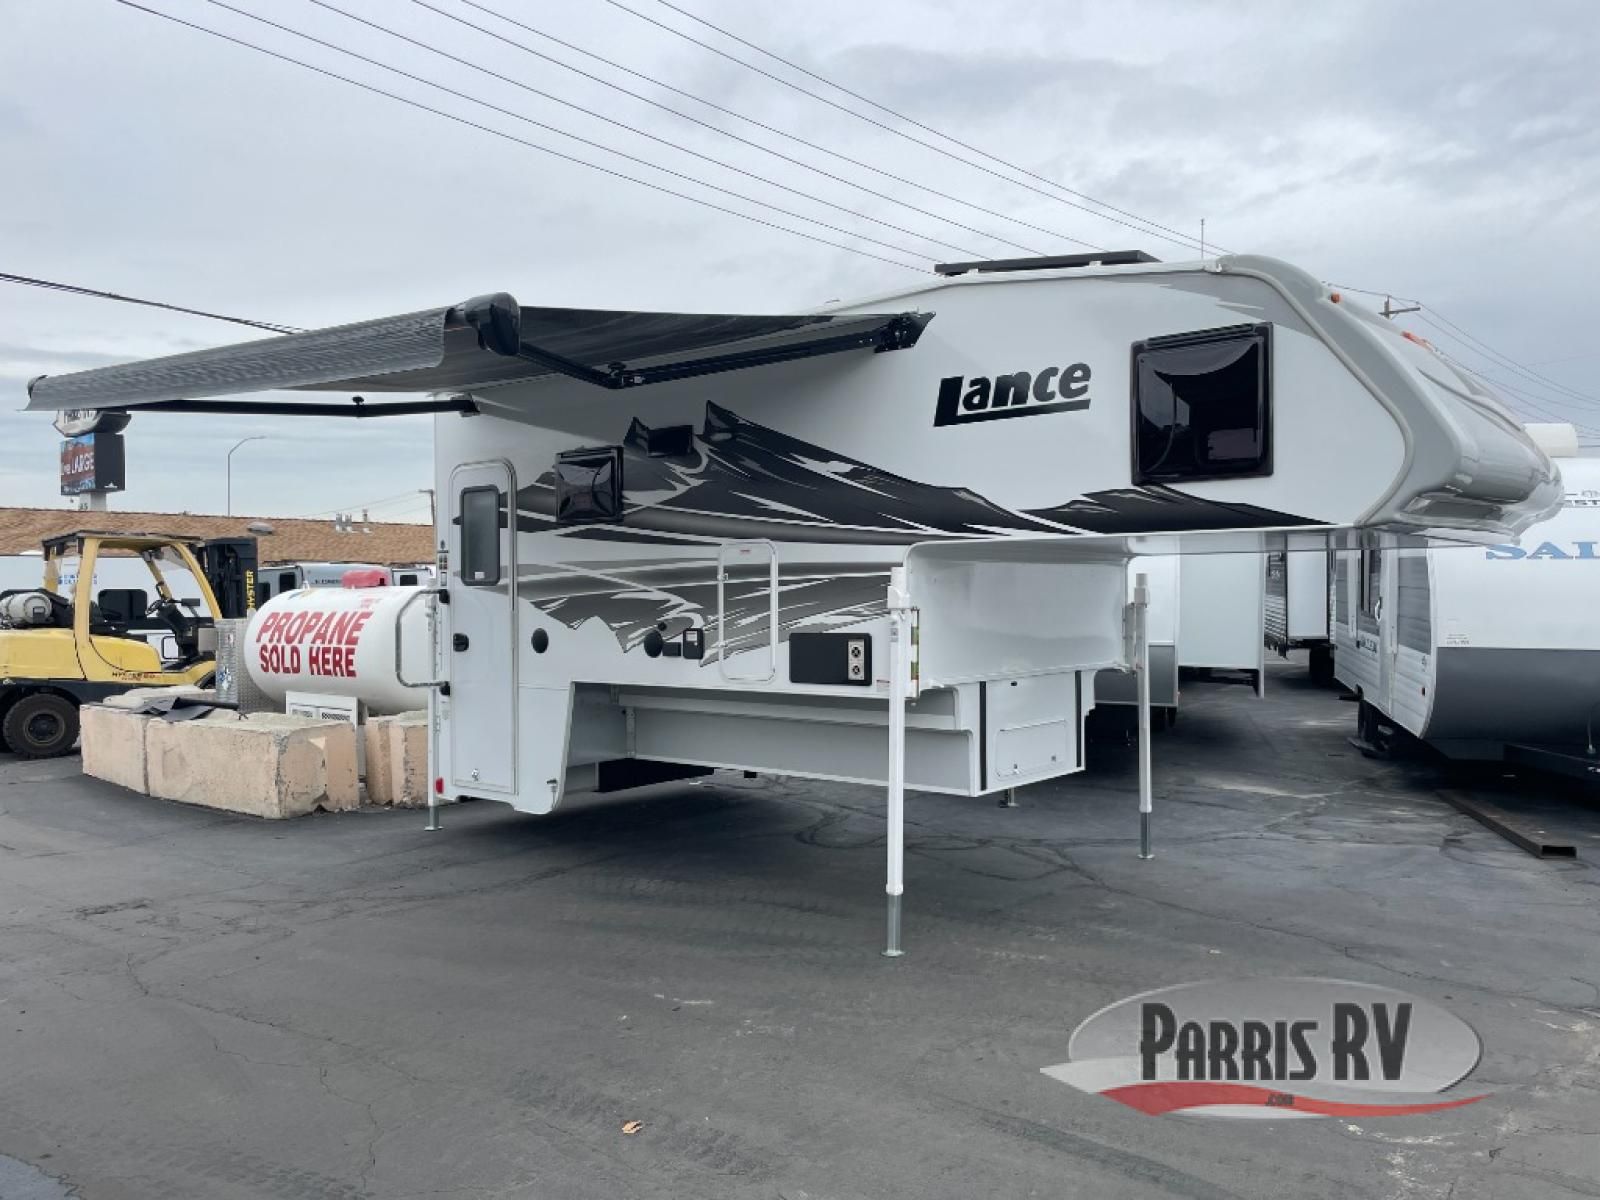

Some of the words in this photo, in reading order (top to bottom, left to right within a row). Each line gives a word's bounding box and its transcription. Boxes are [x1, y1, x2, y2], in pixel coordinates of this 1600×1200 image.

[933, 362, 1092, 427] Lance
[256, 611, 374, 645] PROPANE
[260, 645, 301, 674] SOLD
[309, 646, 357, 677] HERE
